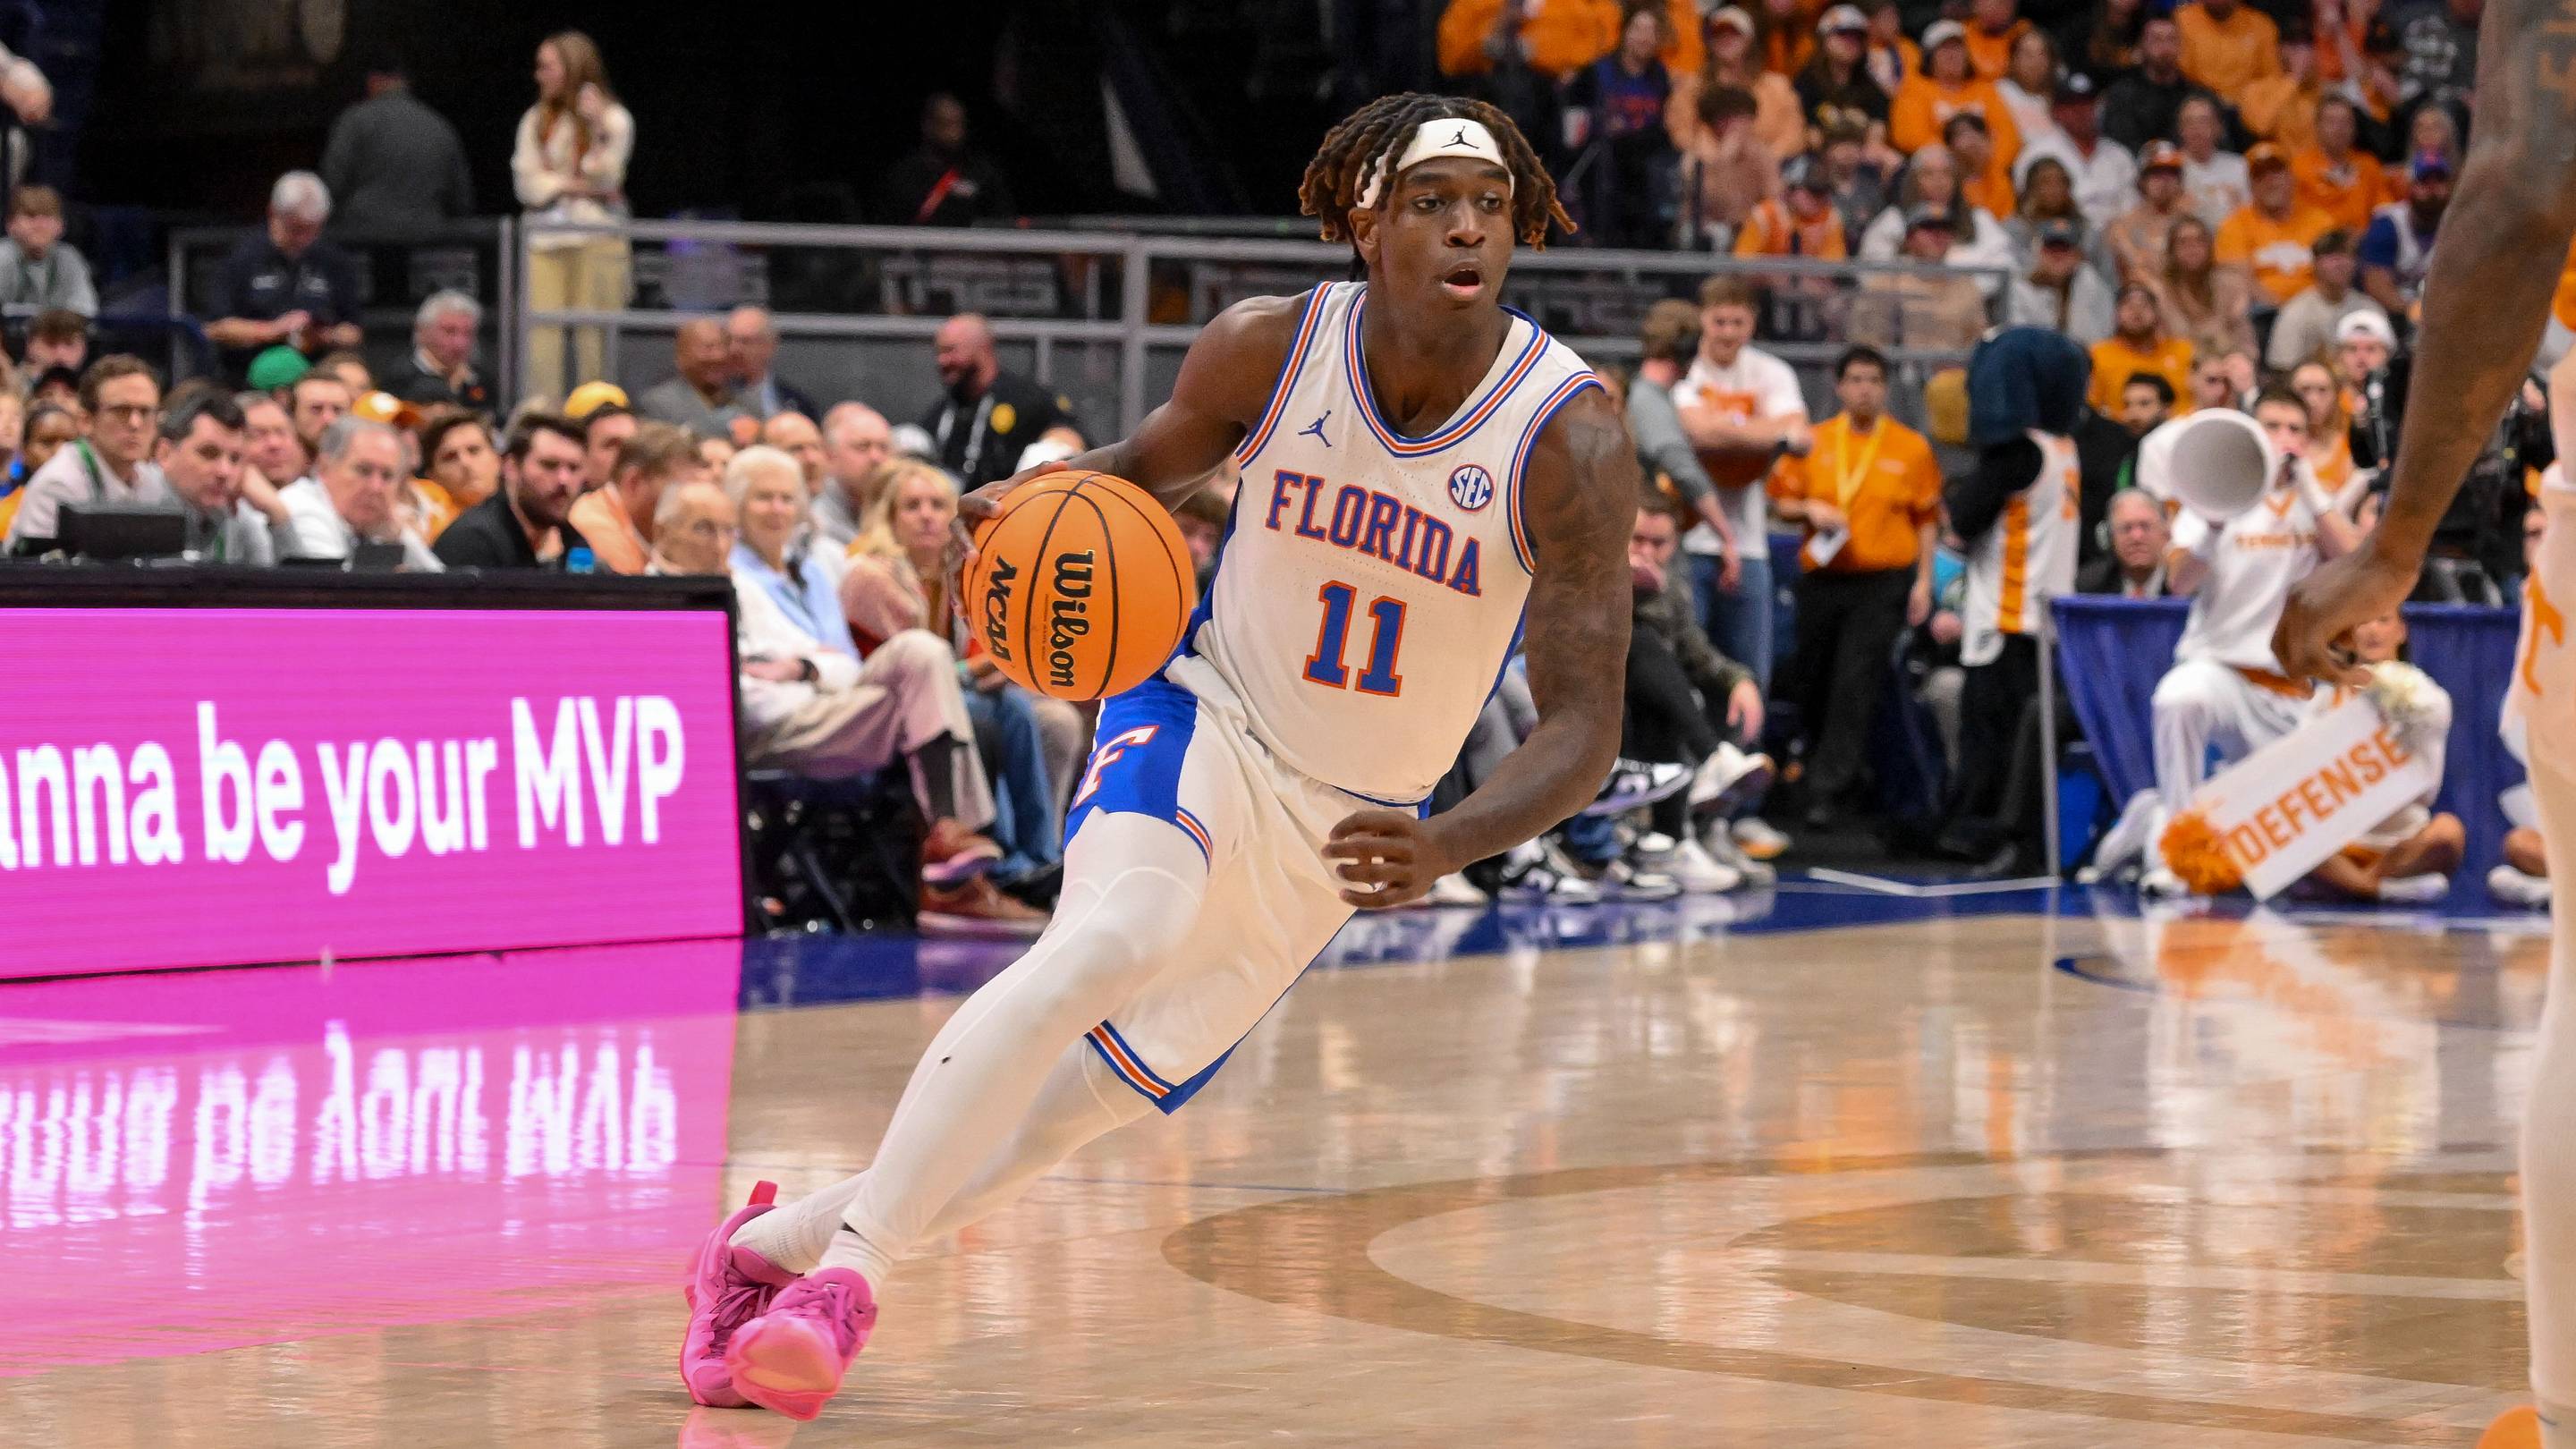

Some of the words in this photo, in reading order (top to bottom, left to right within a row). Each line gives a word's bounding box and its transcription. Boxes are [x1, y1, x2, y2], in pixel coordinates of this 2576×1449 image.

[1265, 469, 1482, 597] FLORIDA
[1451, 466, 1491, 509] SEC
[985, 554, 1018, 662] NCAA
[1049, 549, 1096, 688] Wilson
[1302, 580, 1407, 698] 11
[197, 700, 306, 865] be
[316, 736, 498, 895] your
[511, 695, 685, 849] MVP
[1074, 724, 1160, 809] F
[2228, 726, 2412, 867] DEFENSE
